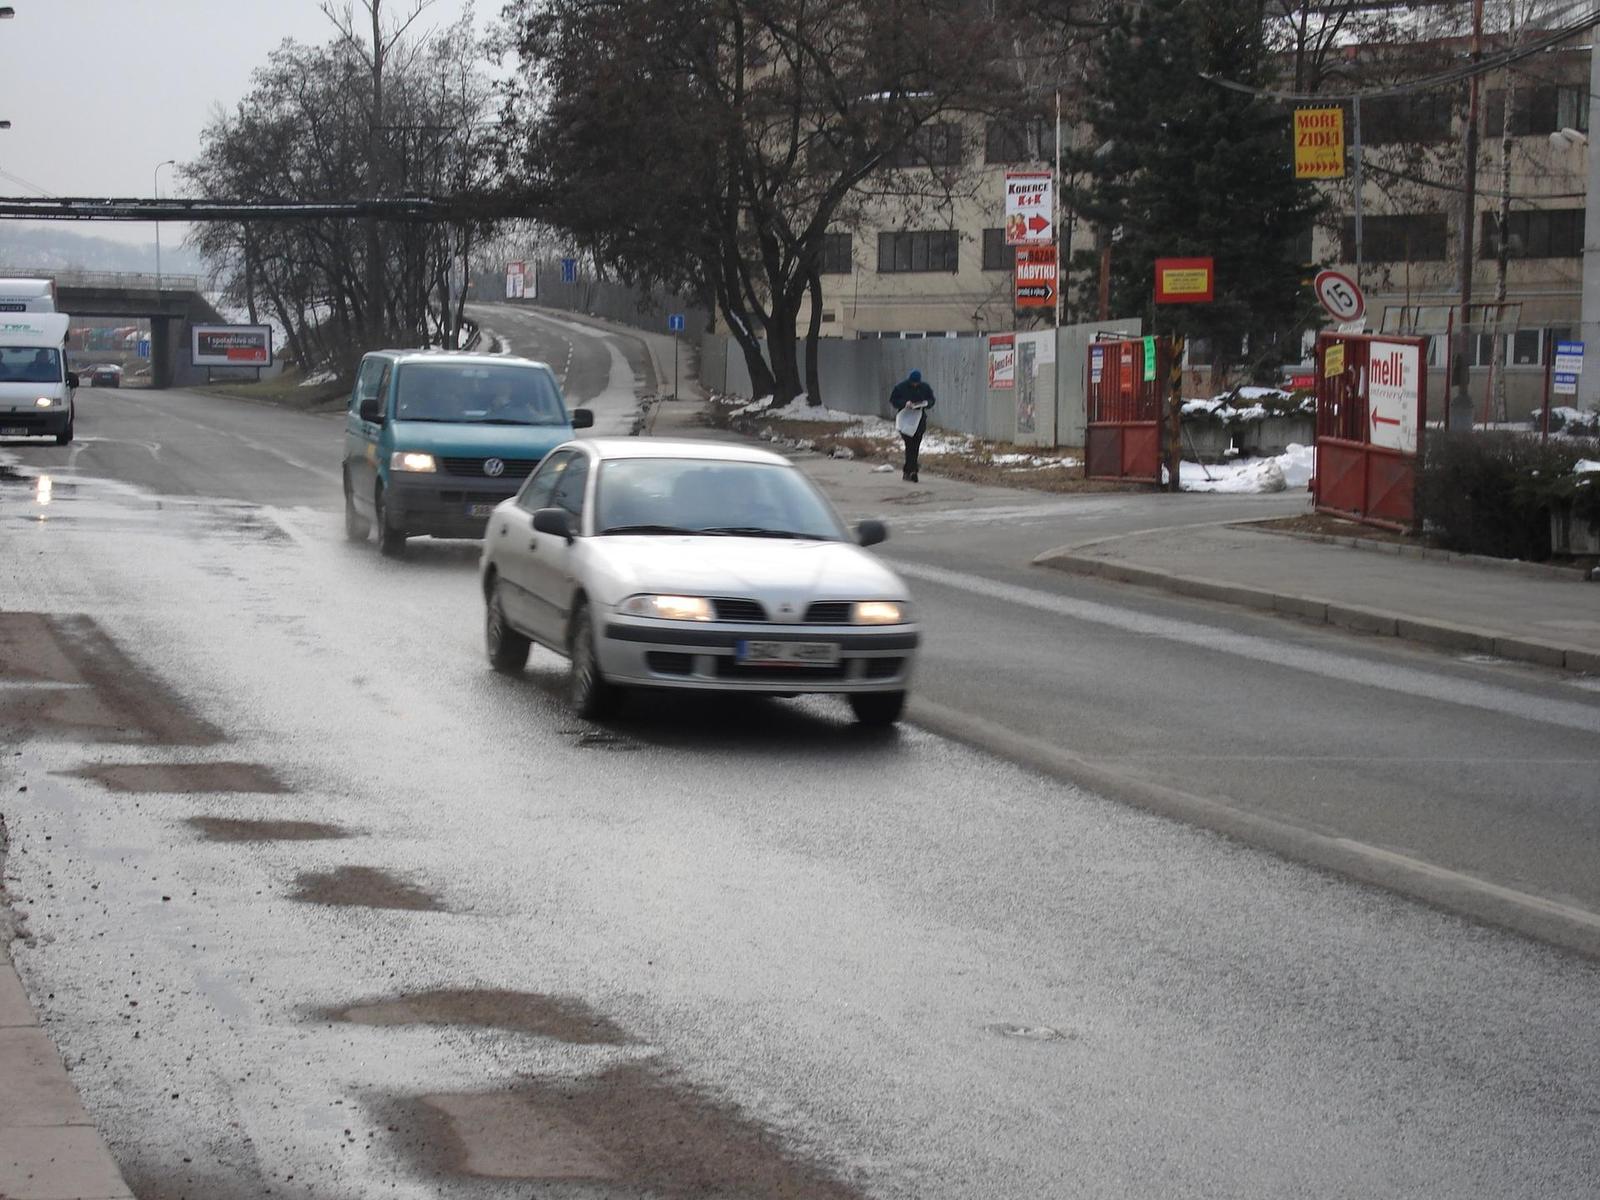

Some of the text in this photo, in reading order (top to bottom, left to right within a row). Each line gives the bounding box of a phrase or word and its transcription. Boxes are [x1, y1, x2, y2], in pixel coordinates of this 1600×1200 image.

[1017, 262, 1056, 280] NÁBYTKU
[1326, 283, 1354, 313] 15
[1370, 351, 1404, 388] melli
